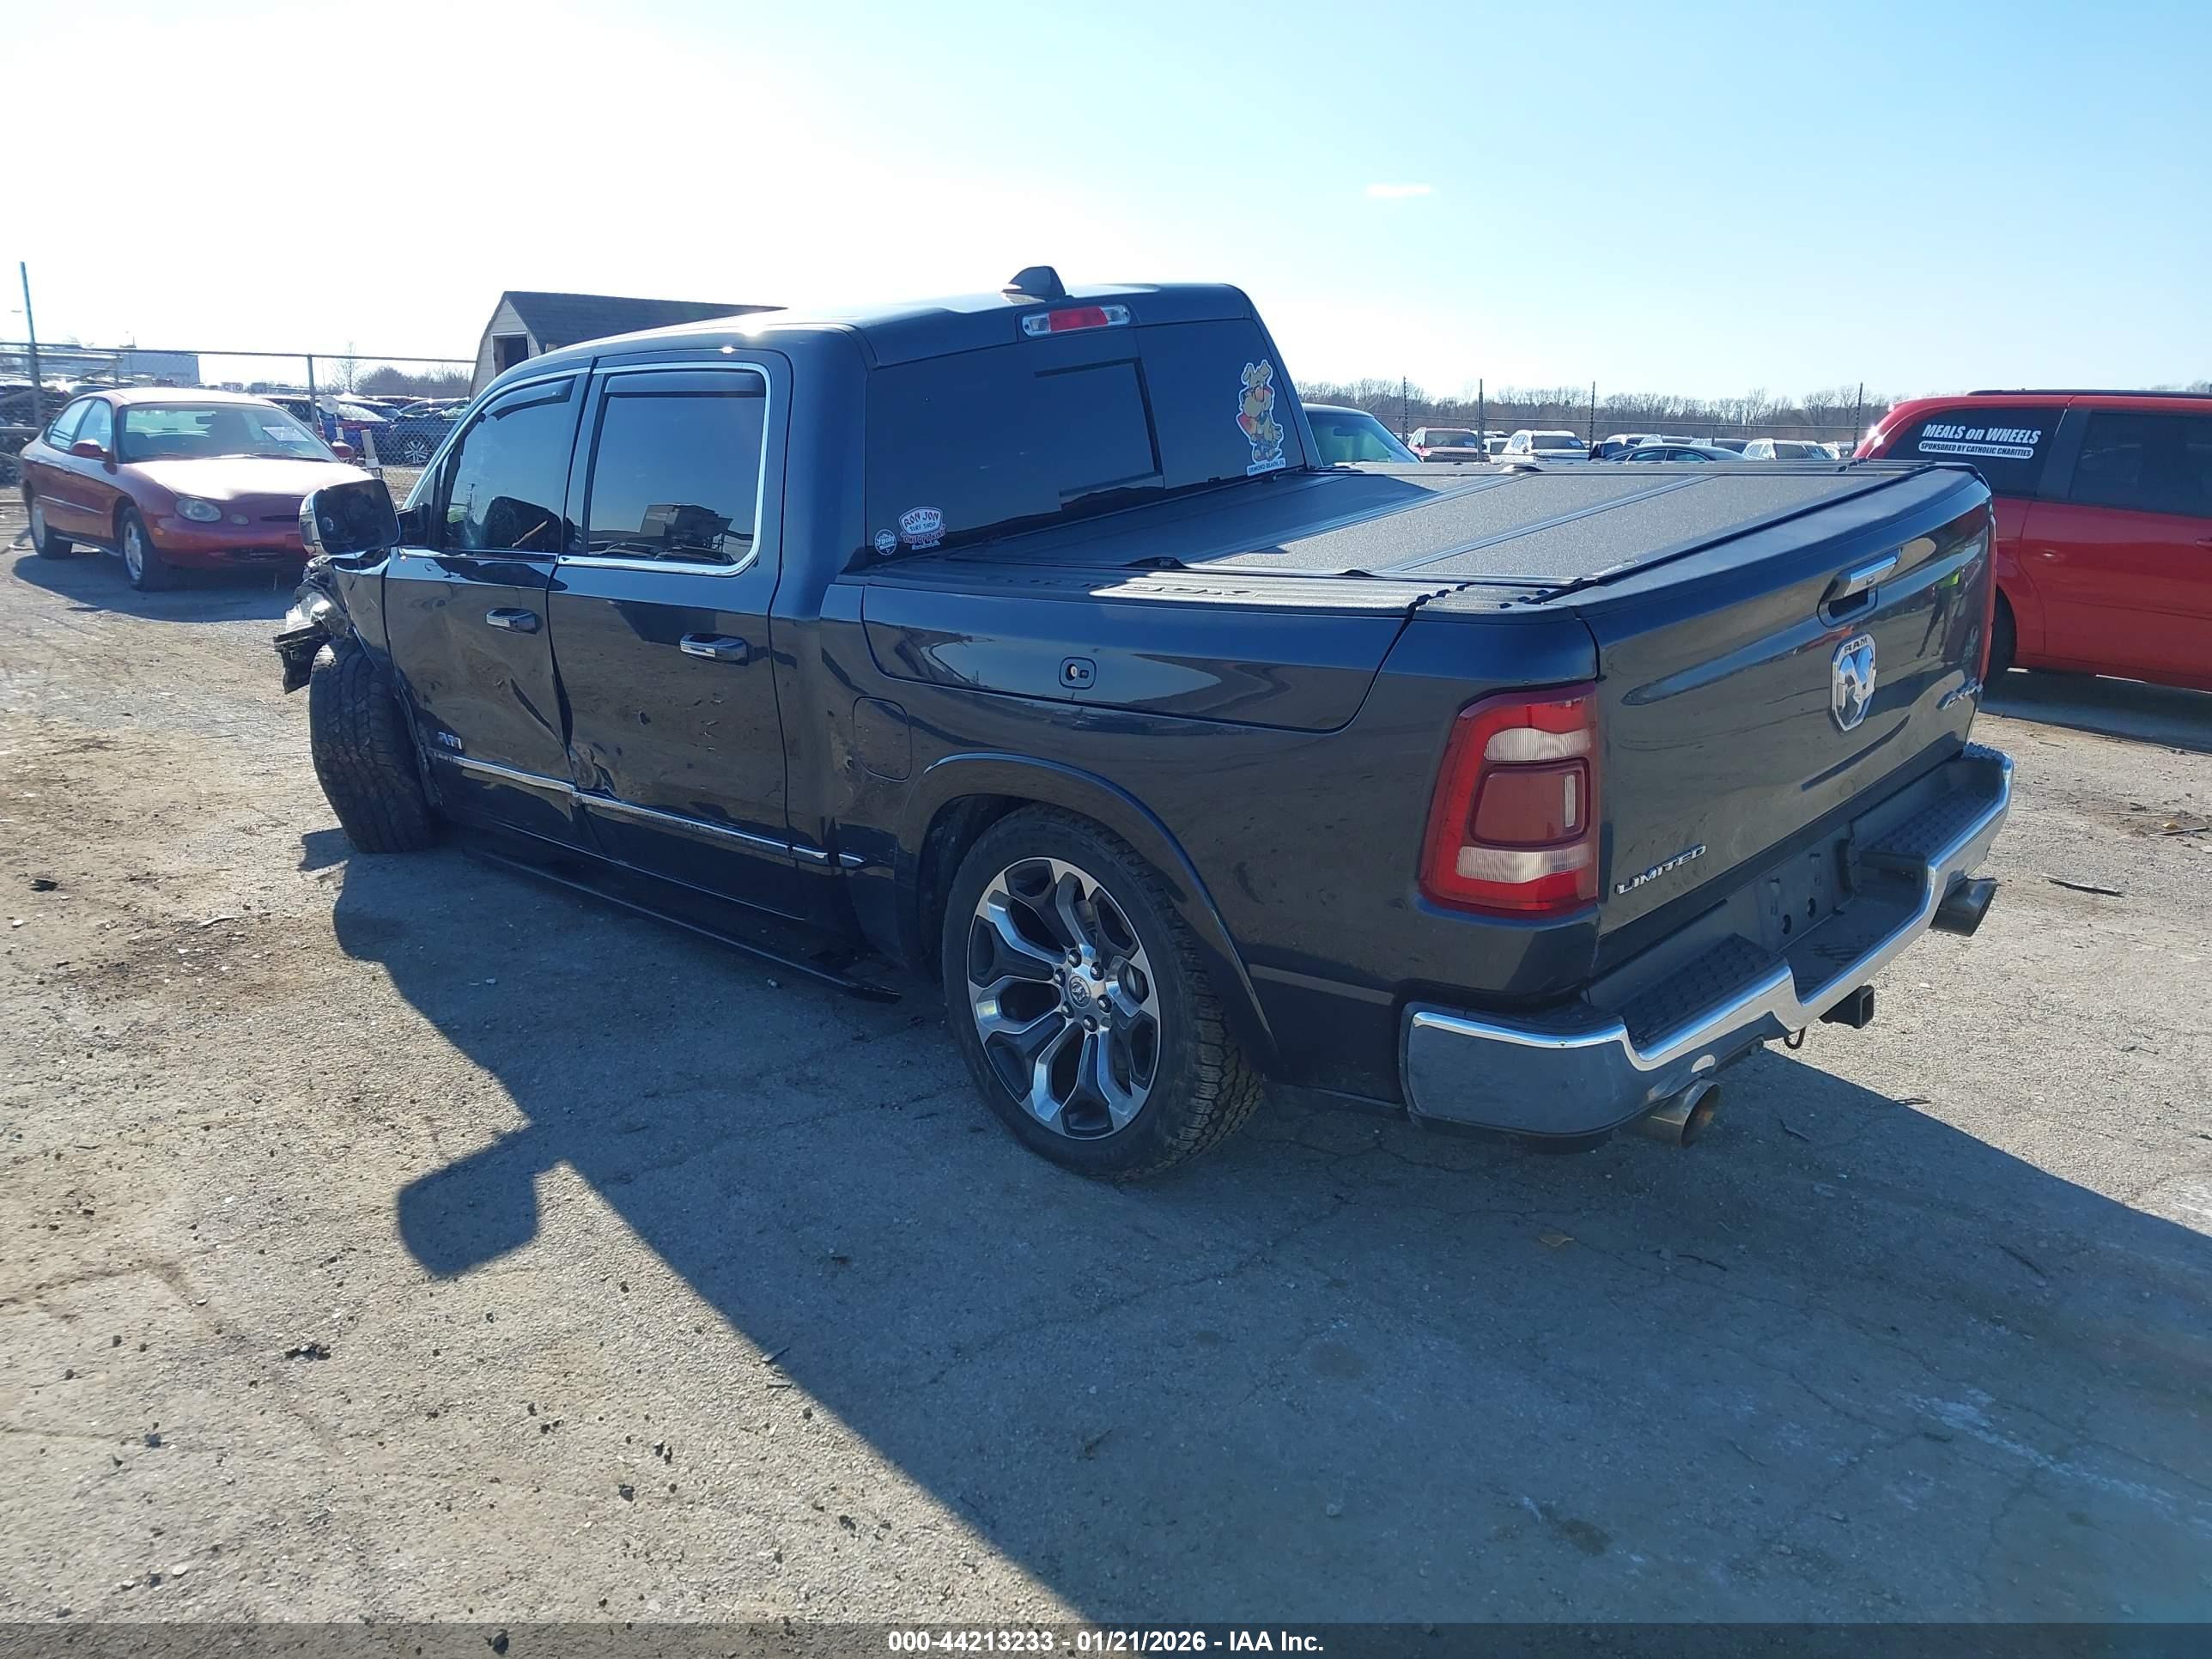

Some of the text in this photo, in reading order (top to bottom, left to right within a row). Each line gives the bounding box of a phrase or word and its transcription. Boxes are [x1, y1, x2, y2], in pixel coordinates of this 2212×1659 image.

[1922, 423, 2042, 445] MEALS on WHEELS
[1920, 442, 1958, 452] SPONSORED
[1966, 446, 1997, 455] CATHOLIC
[1996, 448, 2033, 458] CHARITIES
[904, 512, 939, 527] RON JON
[1844, 637, 1868, 653] RAM
[1615, 843, 1706, 895] LIMITED
